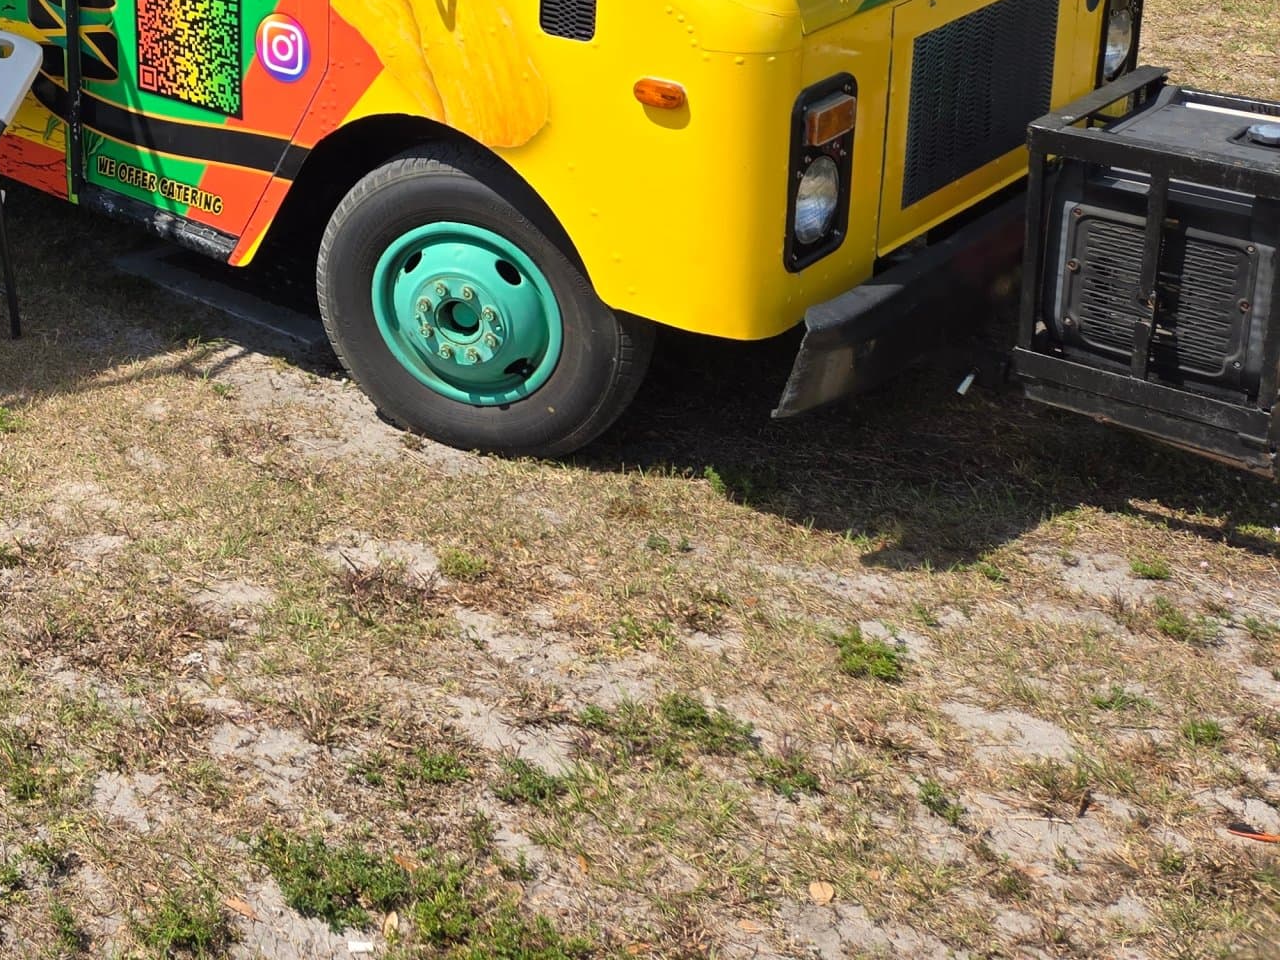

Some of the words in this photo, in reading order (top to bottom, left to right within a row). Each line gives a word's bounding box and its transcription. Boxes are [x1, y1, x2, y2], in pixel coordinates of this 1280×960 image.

[97, 155, 116, 177] WE
[118, 162, 158, 193] OFFER
[159, 177, 224, 216] CATERING
